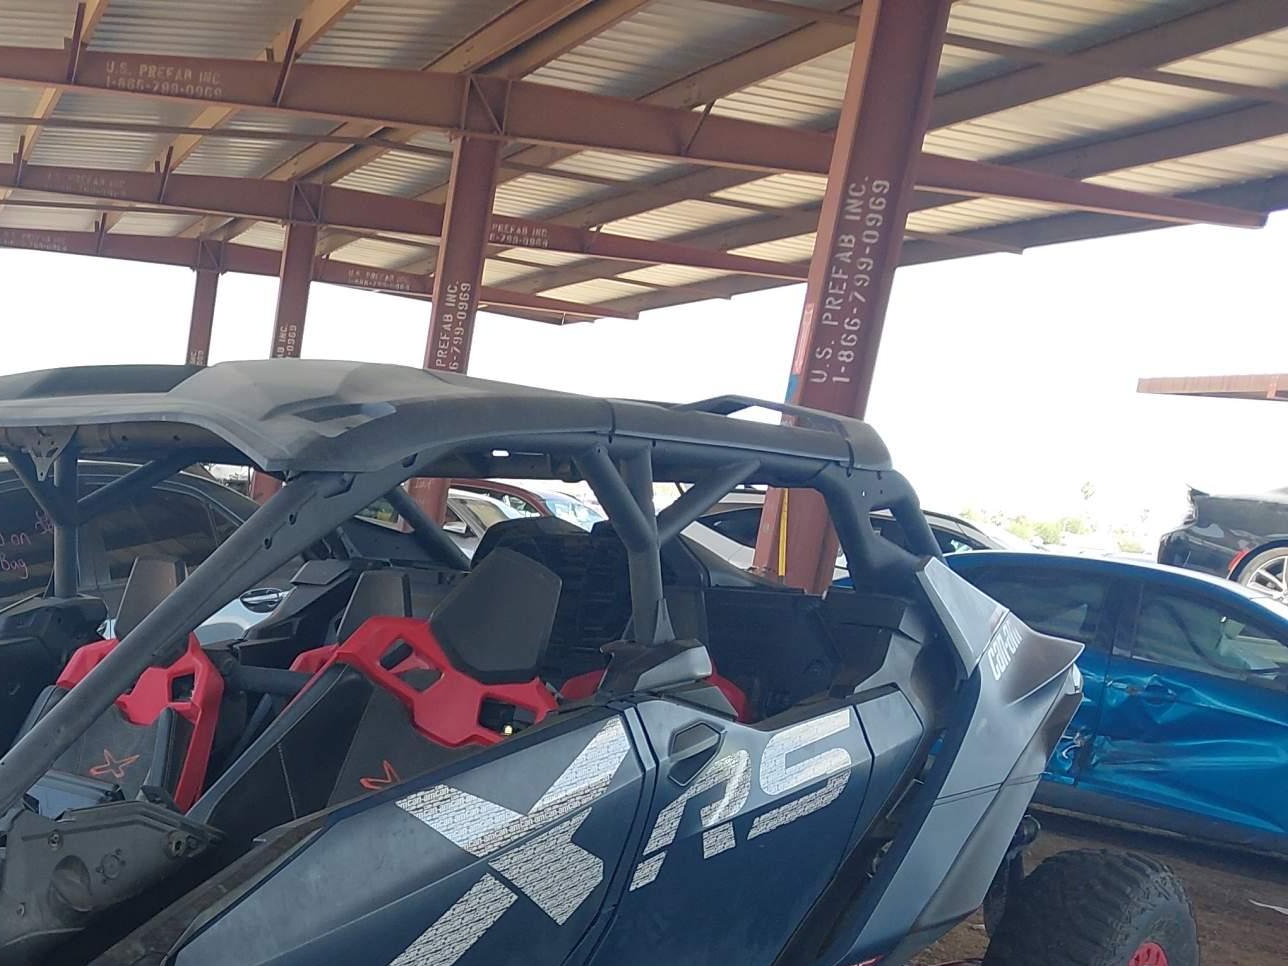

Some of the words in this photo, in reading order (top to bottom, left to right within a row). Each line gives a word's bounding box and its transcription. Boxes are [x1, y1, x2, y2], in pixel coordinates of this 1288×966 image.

[844, 175, 869, 221] INC.
[822, 234, 856, 326] PREFAB
[436, 313, 454, 368] PREFAB
[448, 282, 472, 371] 6-799-0969
[810, 340, 836, 384] U.S.
